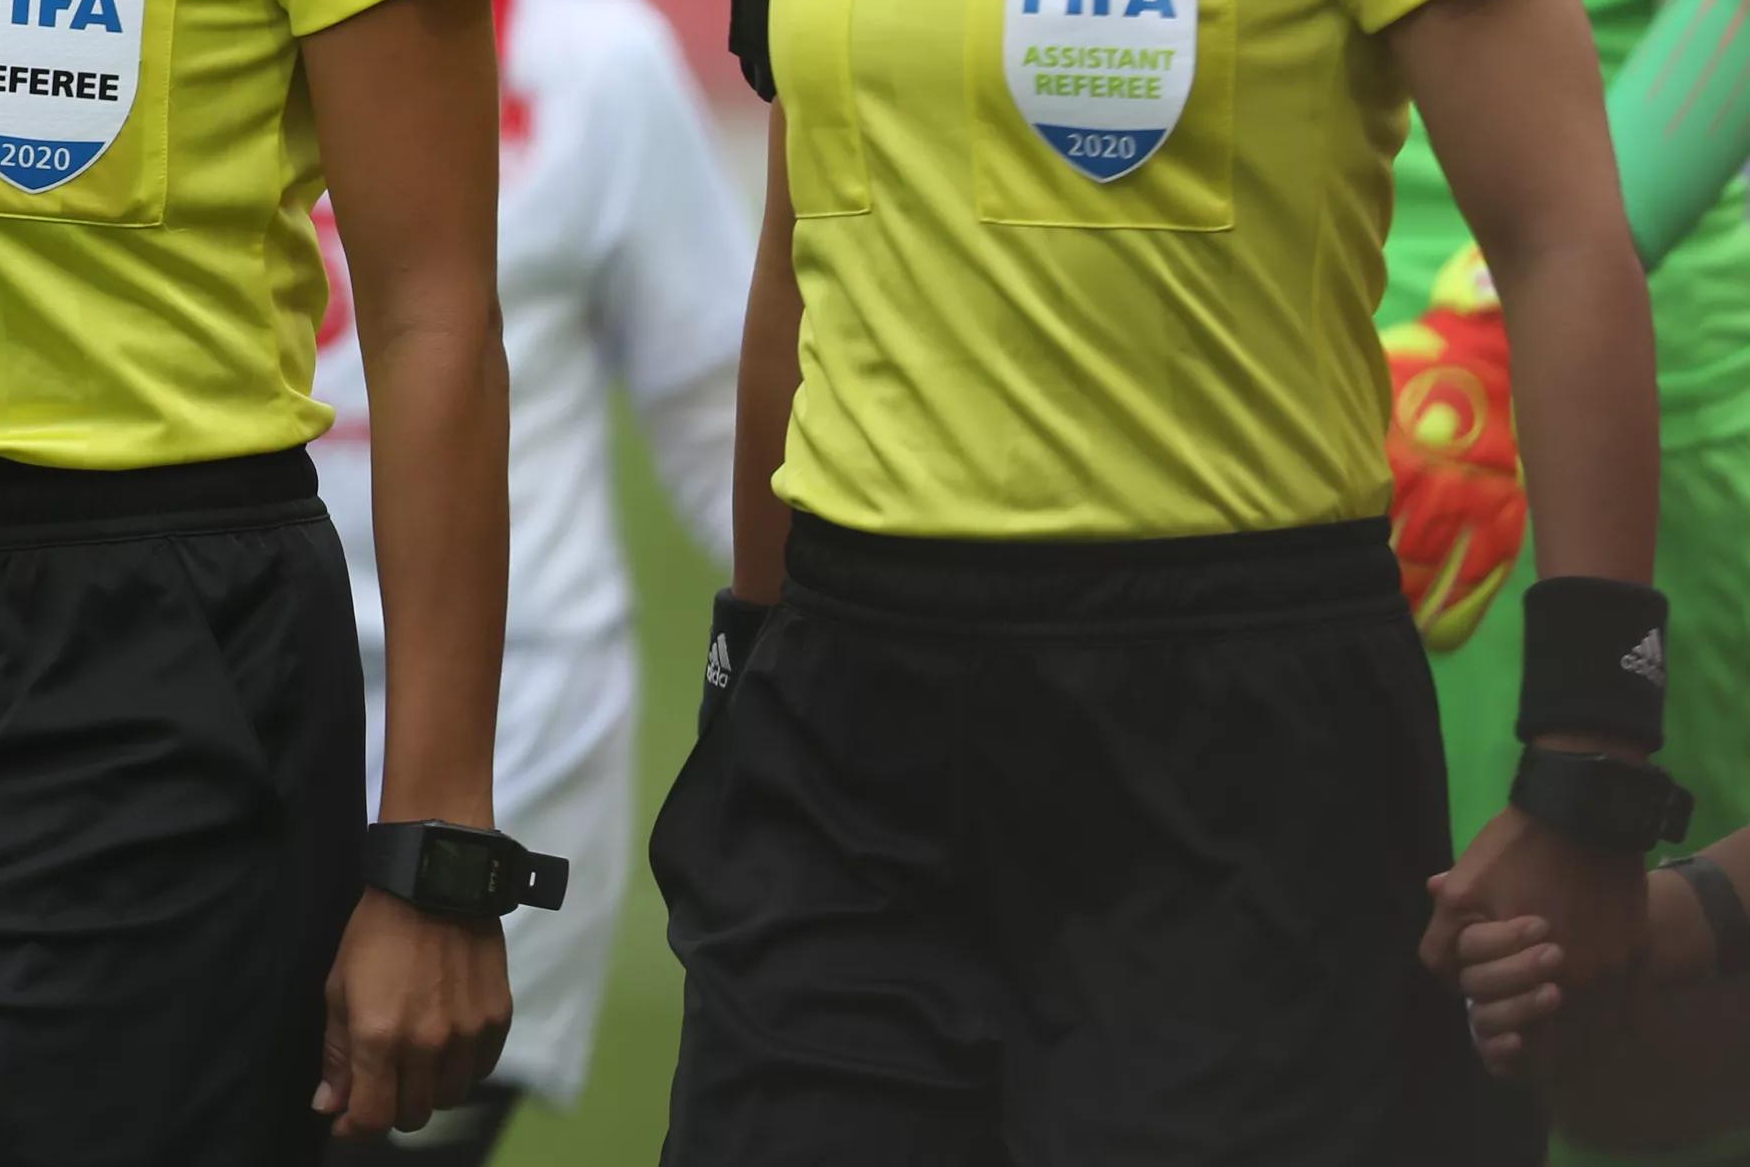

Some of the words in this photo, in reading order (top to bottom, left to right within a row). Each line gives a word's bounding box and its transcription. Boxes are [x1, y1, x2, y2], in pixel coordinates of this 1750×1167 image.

[1022, 45, 1176, 70] ASSISTANT
[1035, 73, 1162, 100] REFEREE
[0, 142, 71, 172] 2020
[1067, 133, 1136, 160] 2020
